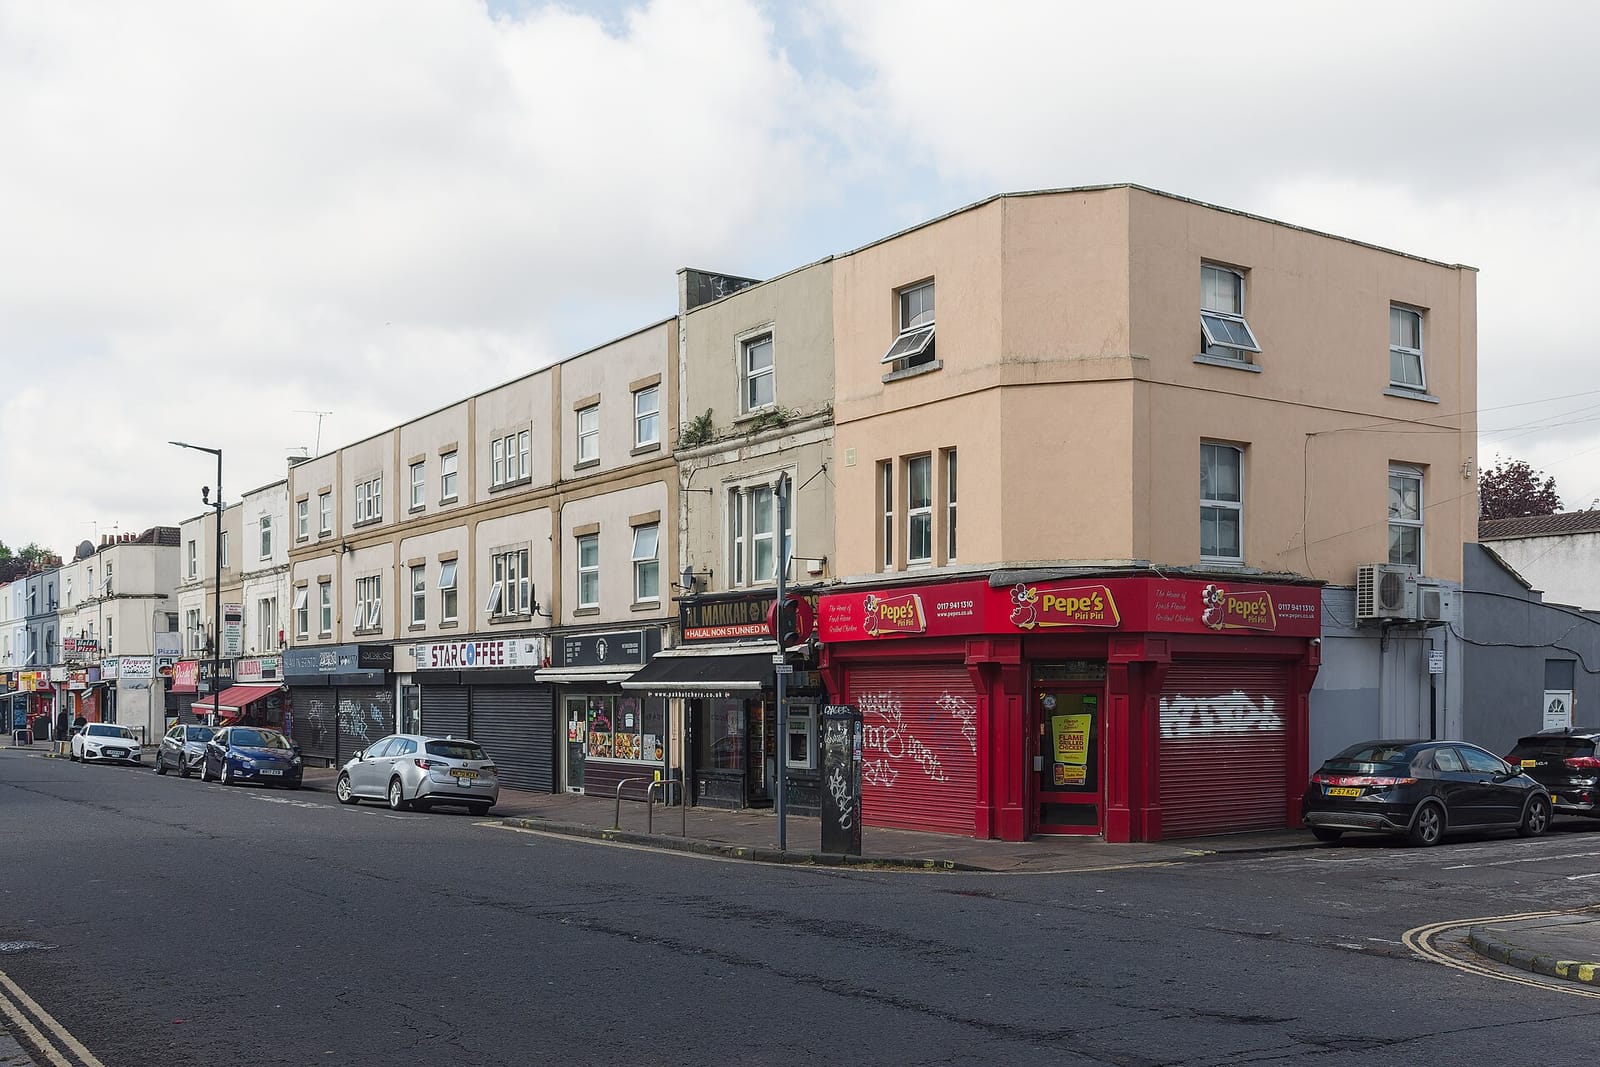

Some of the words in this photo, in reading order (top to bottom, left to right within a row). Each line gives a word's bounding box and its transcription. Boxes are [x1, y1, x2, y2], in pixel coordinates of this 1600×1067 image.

[937, 602, 949, 610] 0117
[949, 601, 960, 609] 941
[960, 600, 973, 608] 1310
[1043, 592, 1104, 616] Pepe's
[1228, 597, 1267, 619] Pepe's
[1278, 603, 1291, 611] 0117
[687, 606, 698, 627] AL
[701, 601, 747, 626] MAKKAH
[880, 600, 914, 623] Pepe's
[937, 610, 973, 618] www.pepes.co.uk
[1075, 612, 1089, 620] Piri
[1090, 612, 1104, 620] Piri
[906, 618, 914, 626] Piri
[1248, 615, 1257, 623] Piri
[1258, 616, 1267, 624] Piri
[690, 628, 711, 637] HALAL
[711, 627, 726, 636] NON
[726, 625, 759, 636] STUNNED
